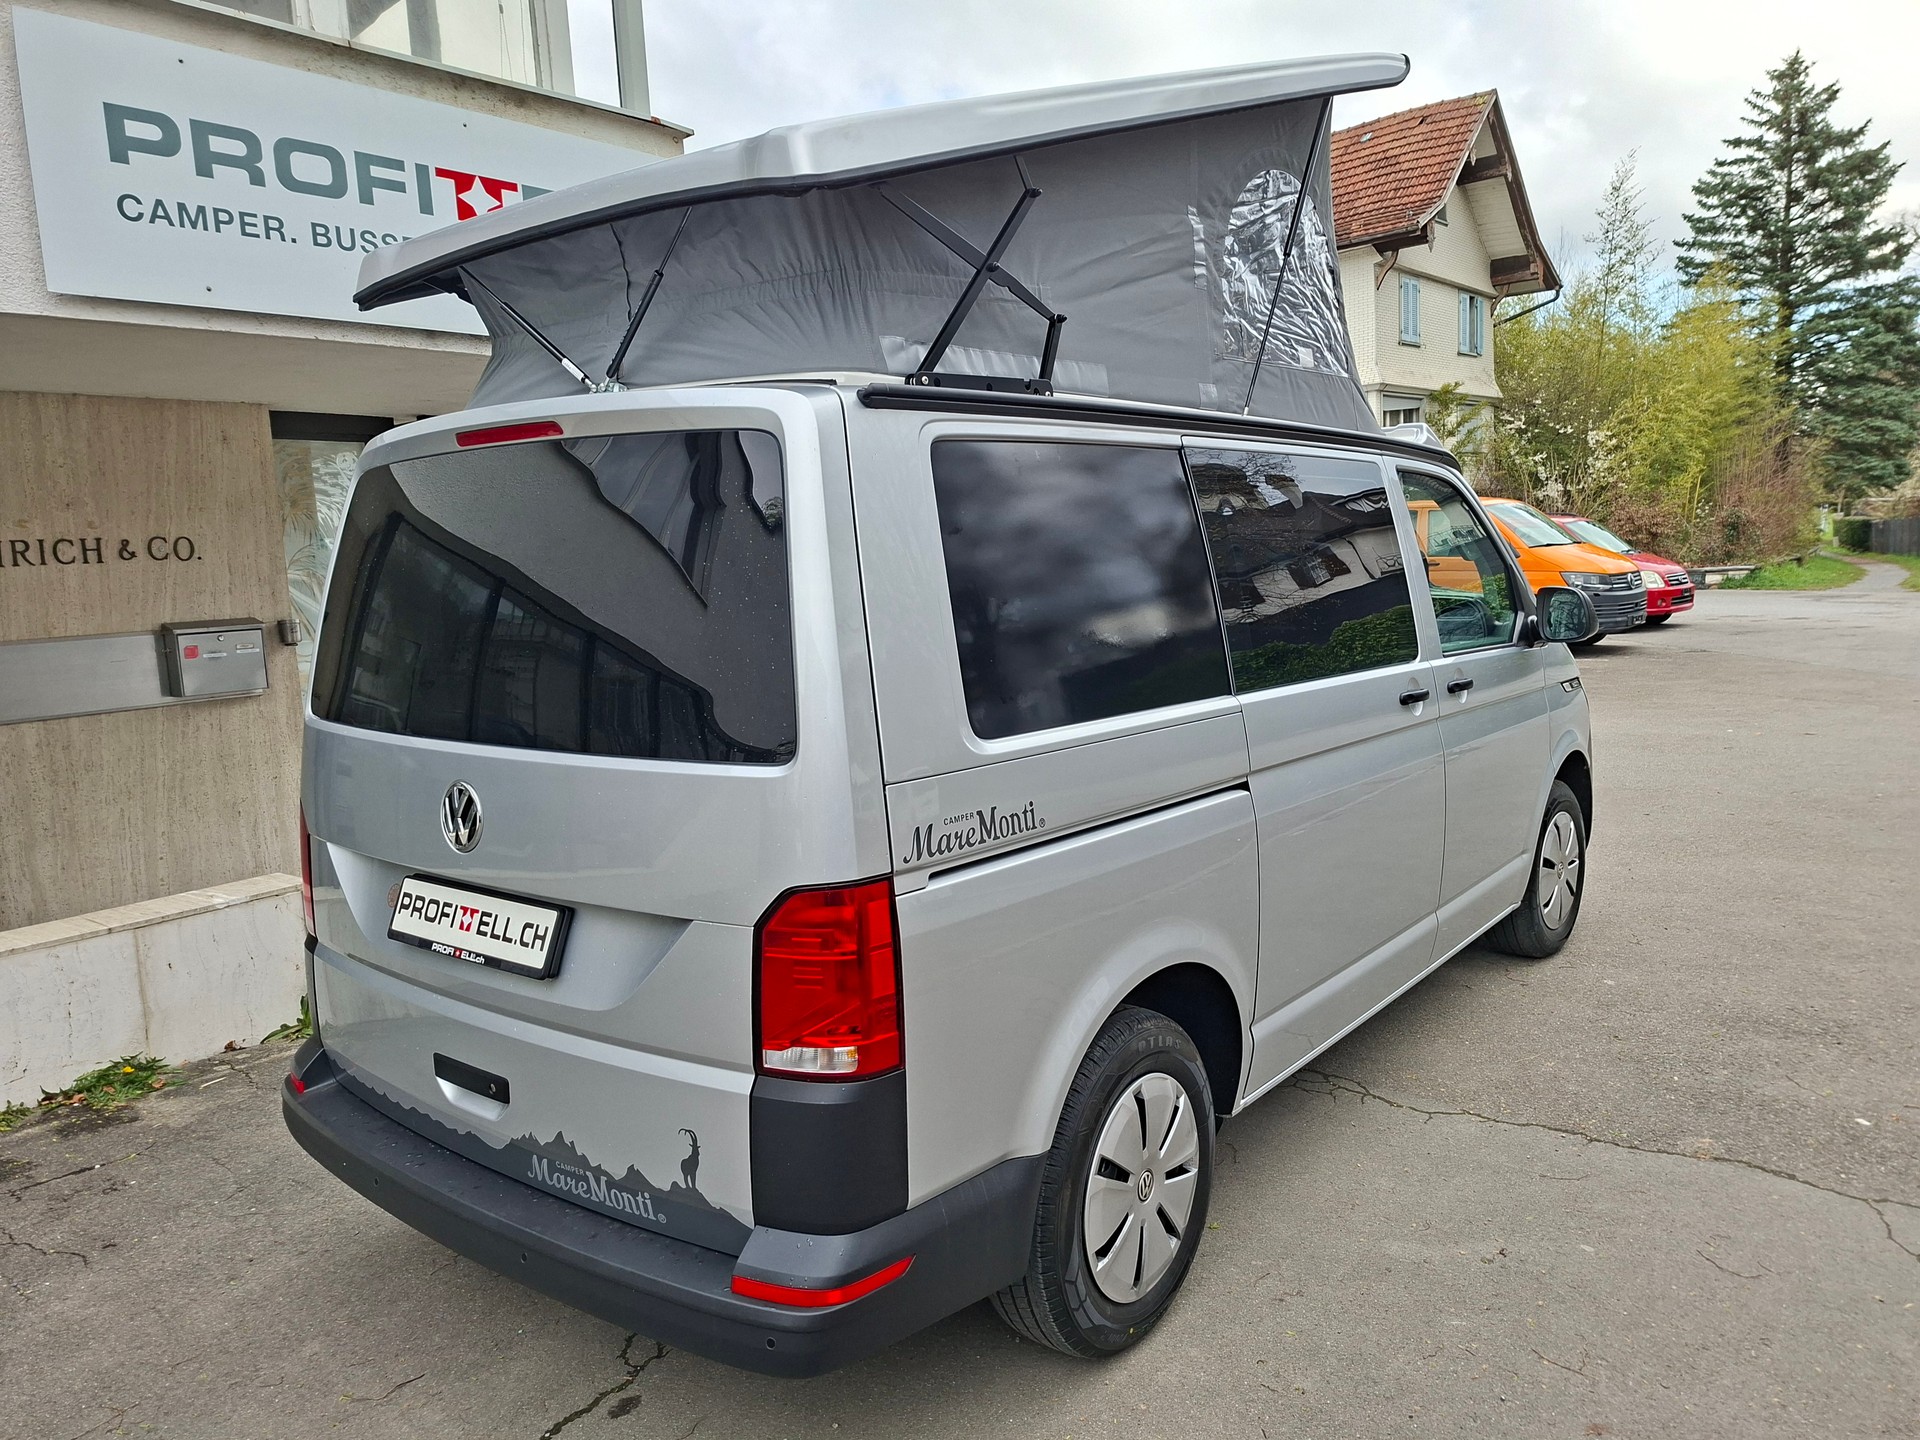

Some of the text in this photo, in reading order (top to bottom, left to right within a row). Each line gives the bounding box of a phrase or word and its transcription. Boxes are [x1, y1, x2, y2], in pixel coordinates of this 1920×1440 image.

[117, 193, 297, 244] CAMPER.
[118, 538, 138, 562] &
[147, 536, 203, 562] CO.
[943, 811, 975, 826] CAMPER
[398, 891, 549, 951] PROFITELL.CH
[555, 1160, 585, 1176] CAMPER
